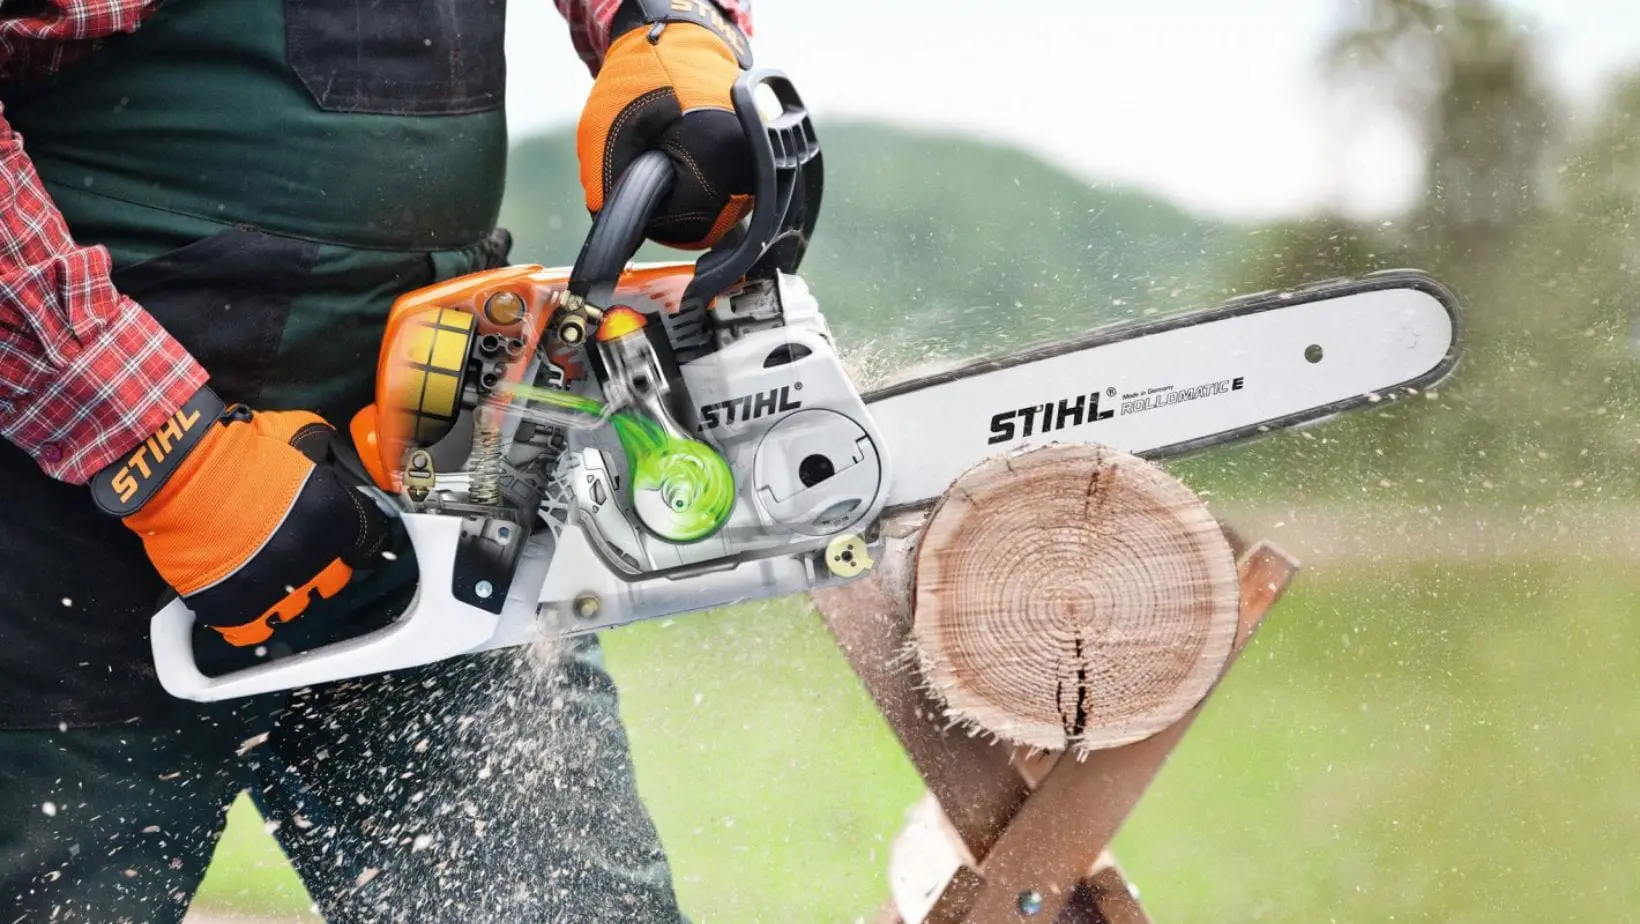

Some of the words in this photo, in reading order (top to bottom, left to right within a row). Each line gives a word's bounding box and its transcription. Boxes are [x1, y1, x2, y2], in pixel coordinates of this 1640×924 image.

[1120, 379, 1230, 415] ROLLOMATIC
[1231, 376, 1244, 391] E
[1122, 392, 1139, 400] Made
[111, 409, 201, 504] STIHL
